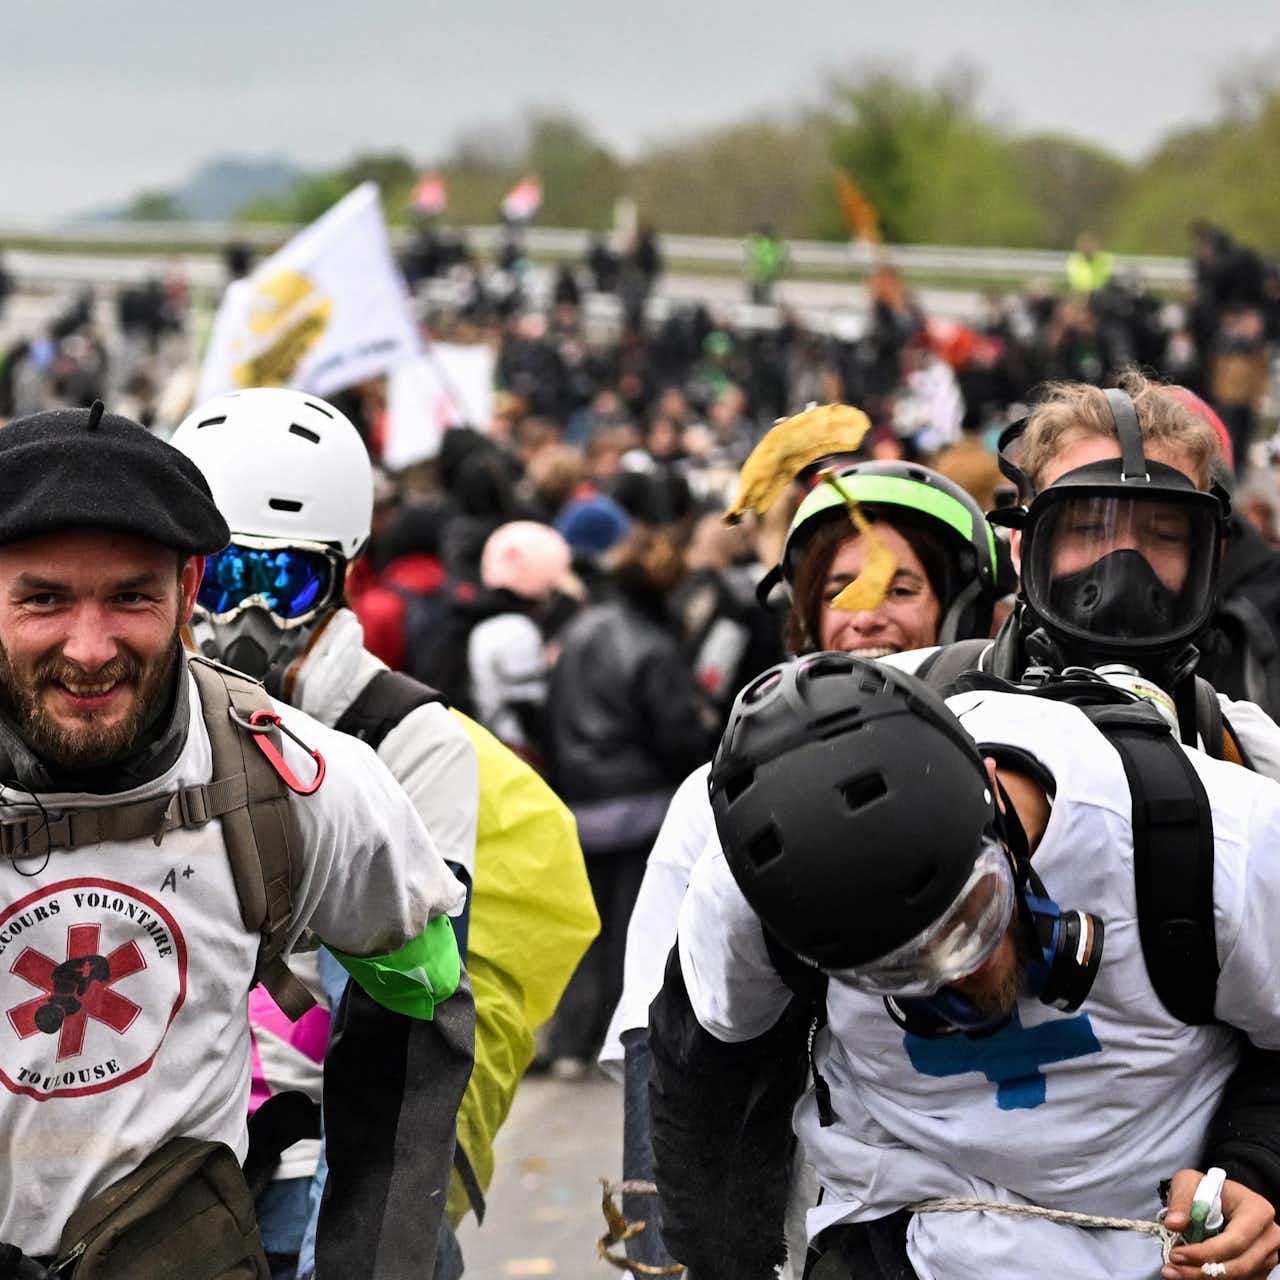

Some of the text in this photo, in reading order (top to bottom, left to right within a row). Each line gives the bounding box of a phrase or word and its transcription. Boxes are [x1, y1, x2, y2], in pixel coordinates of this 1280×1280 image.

[160, 865, 195, 893] A+
[73, 892, 173, 959] VOLONTAIRE
[17, 1058, 121, 1091] TOULOUSE
